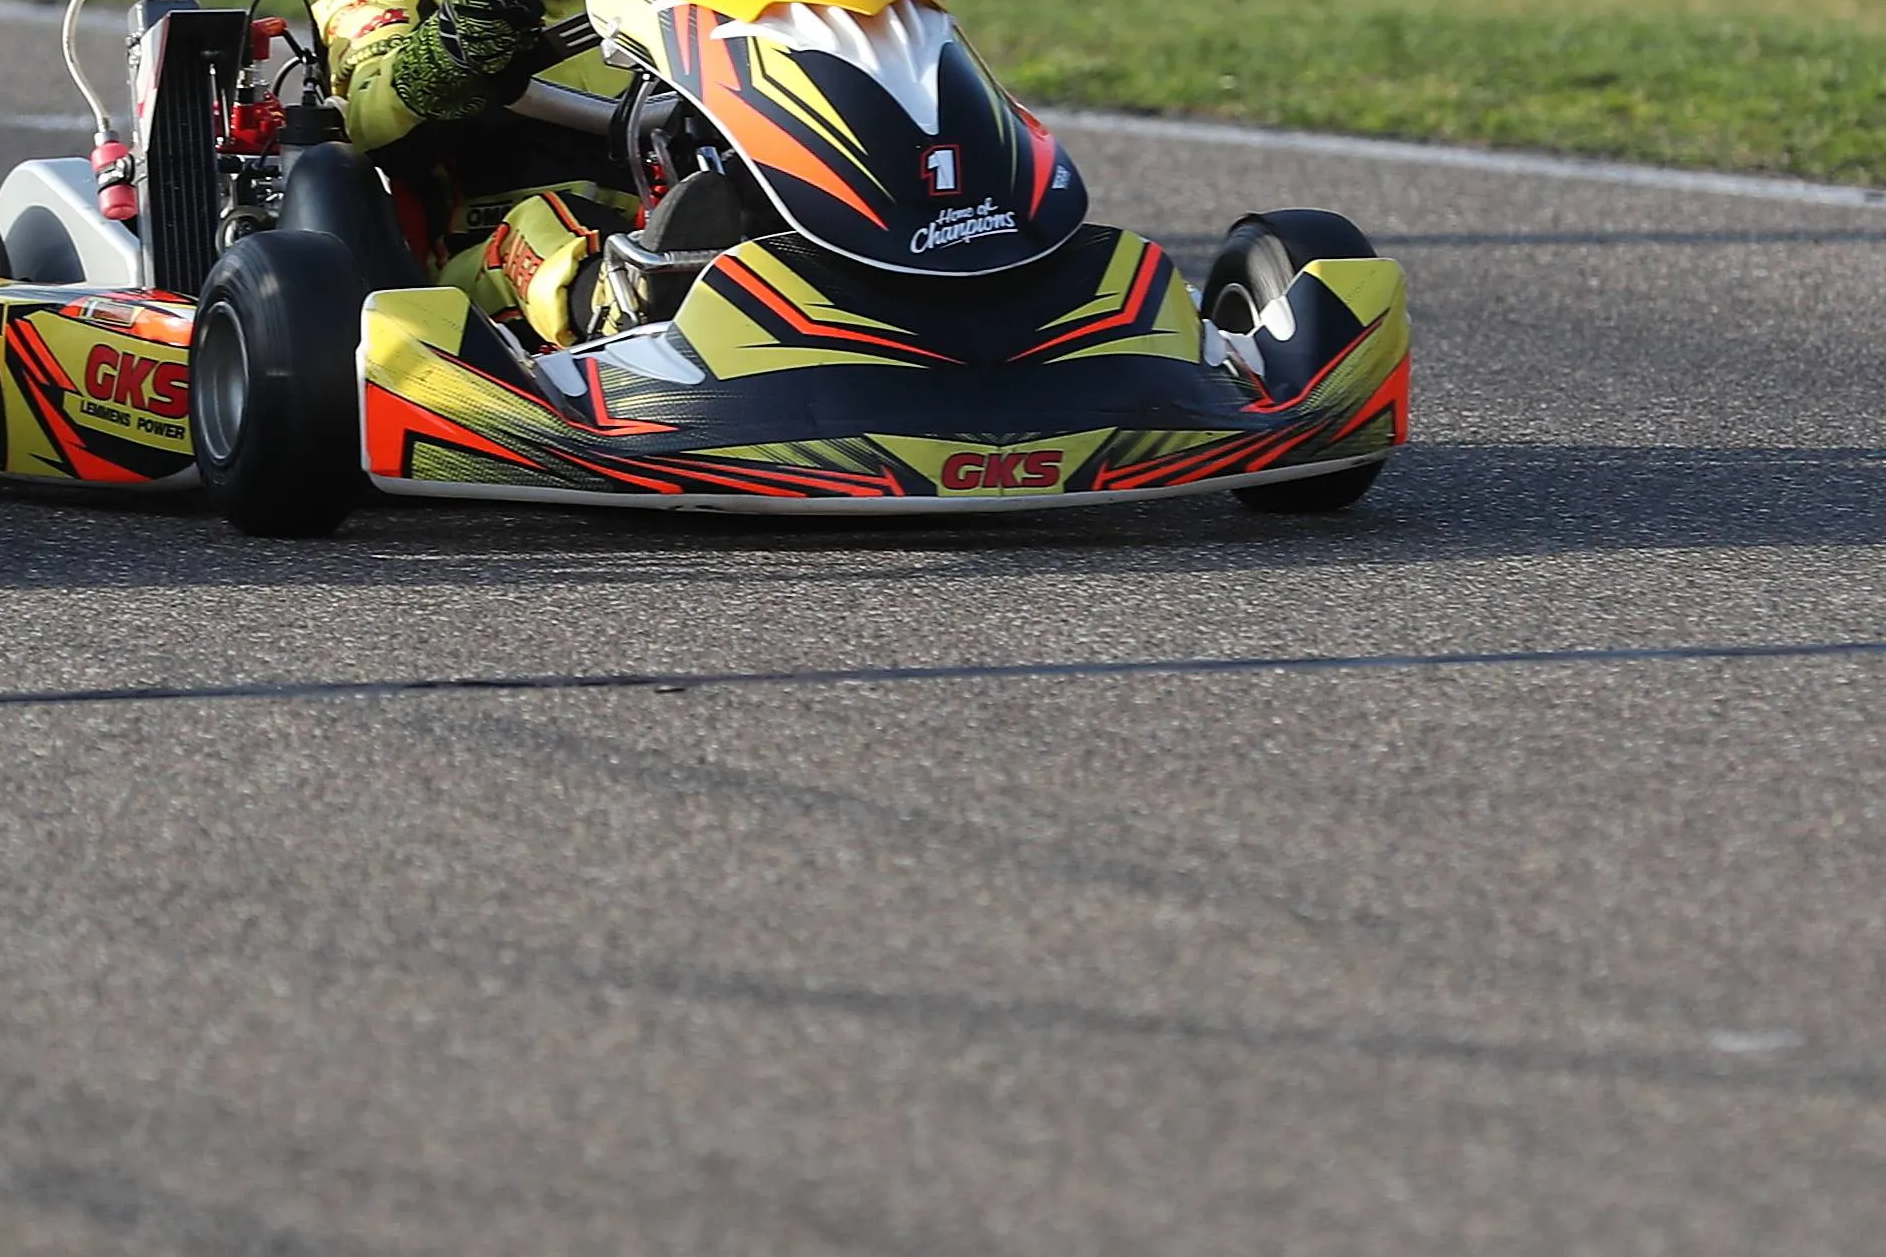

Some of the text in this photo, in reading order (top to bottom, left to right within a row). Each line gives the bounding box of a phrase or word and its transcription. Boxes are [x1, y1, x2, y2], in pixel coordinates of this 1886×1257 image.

[926, 148, 959, 193] 1
[910, 212, 1017, 254] Champions
[85, 343, 190, 420] GKS
[80, 399, 187, 441] LEMMENS POWER
[941, 450, 1064, 491] GKS
